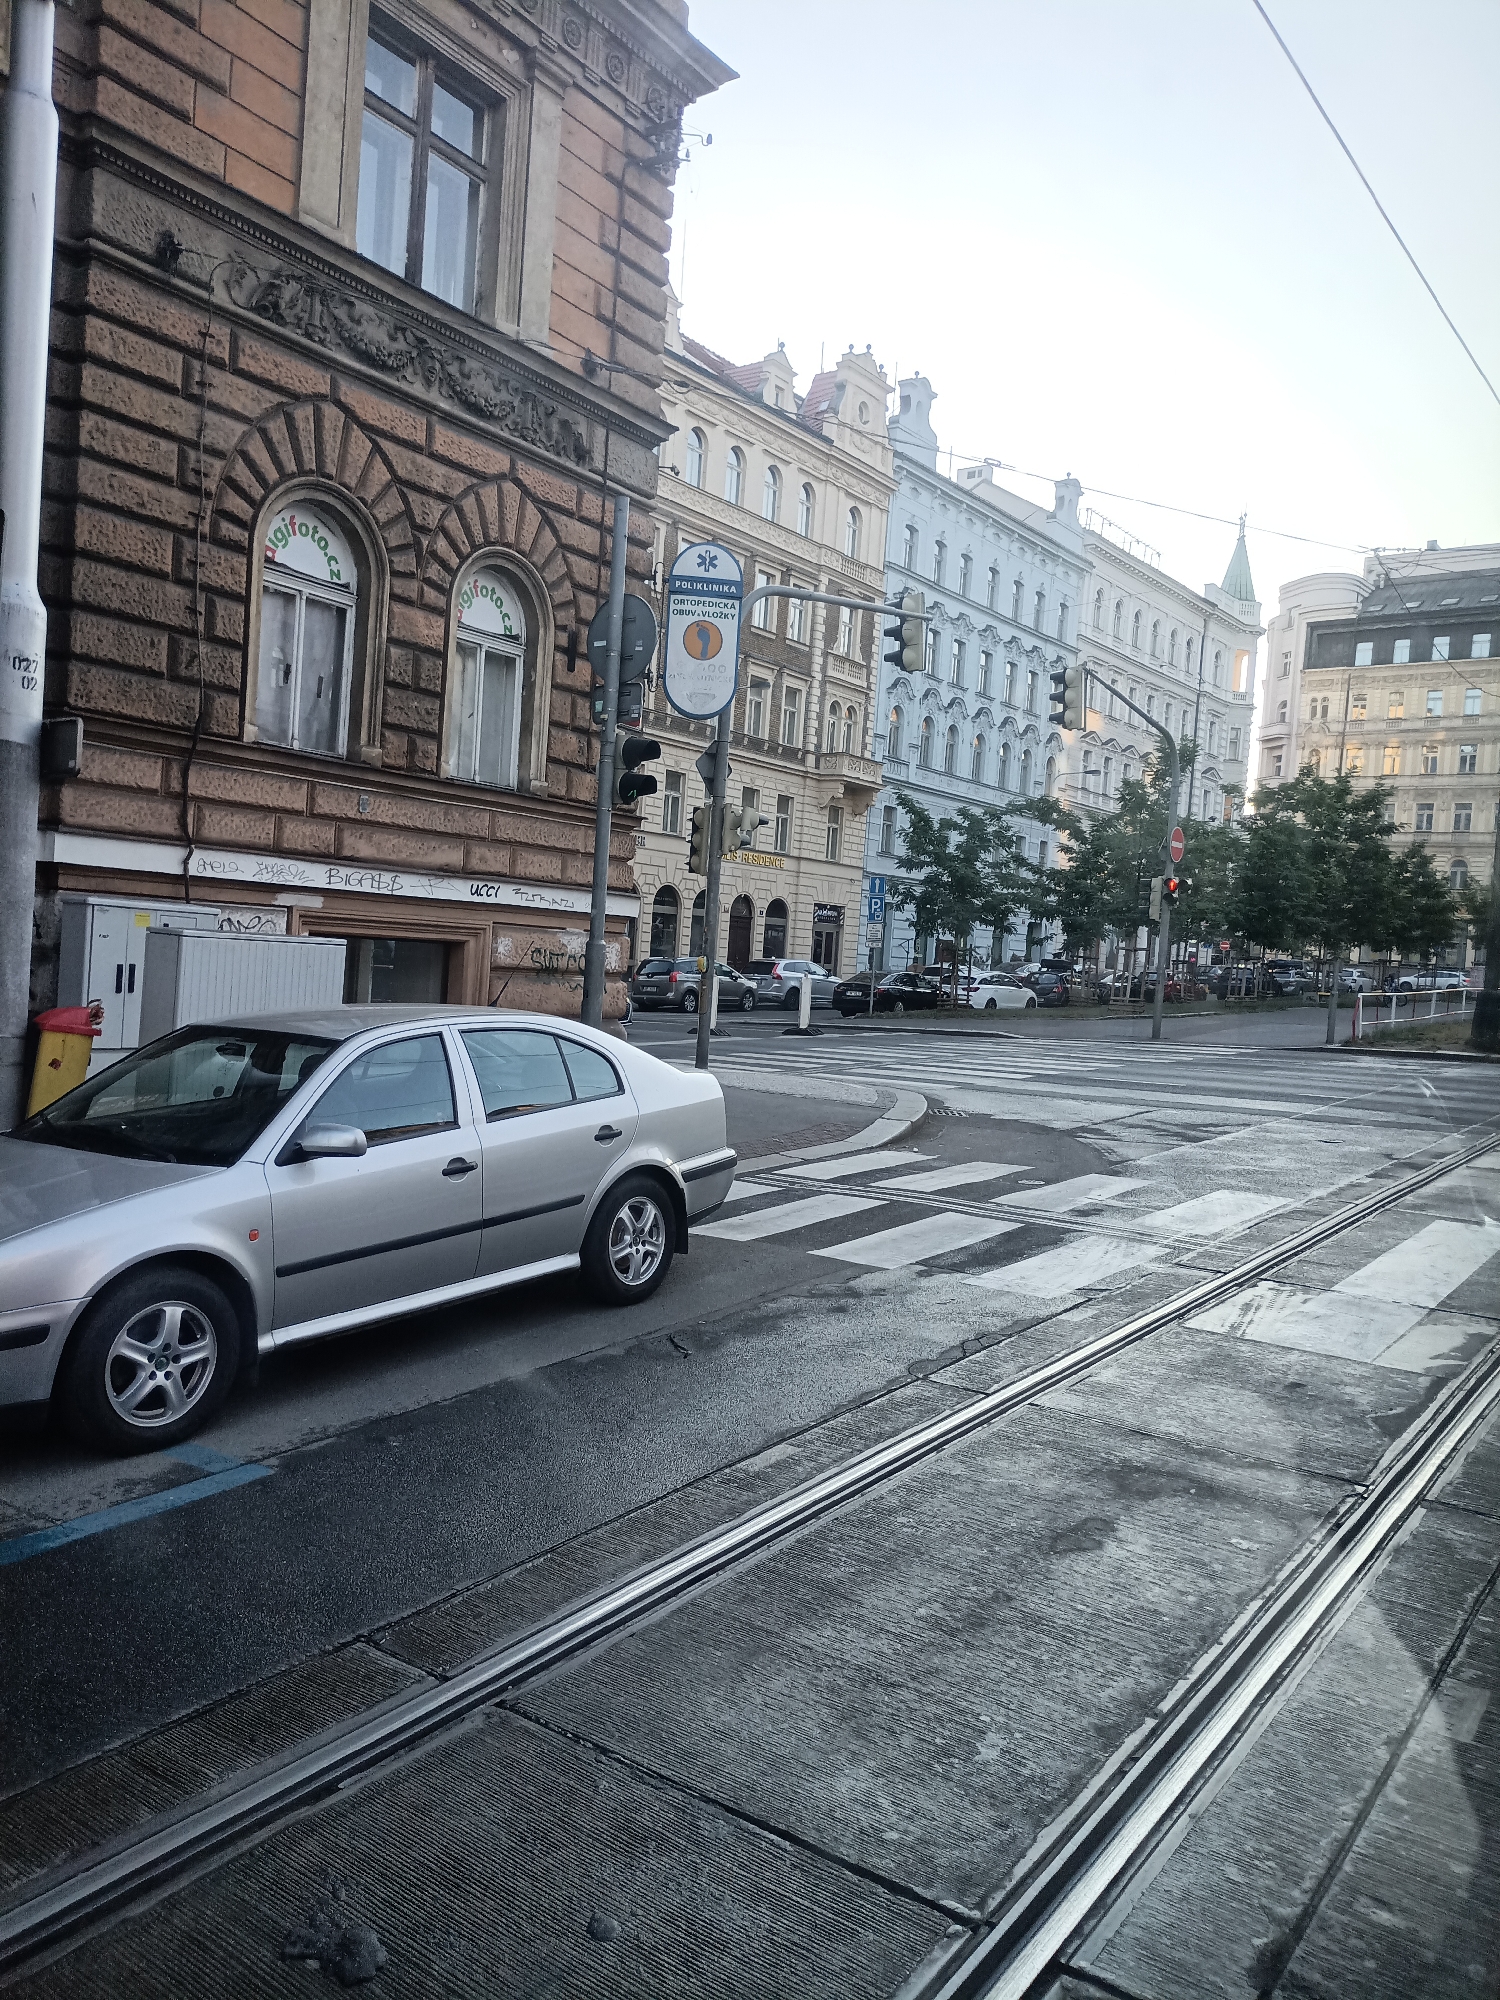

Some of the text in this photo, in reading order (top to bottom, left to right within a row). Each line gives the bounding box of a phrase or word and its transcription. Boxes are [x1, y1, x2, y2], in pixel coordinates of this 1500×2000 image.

[675, 580, 737, 593] POLIKLINIKA
[673, 598, 736, 610] ORTOPEDICKÁ
[672, 608, 697, 617] OBUV
[701, 609, 736, 620] VLOŽKY
[21, 675, 38, 691] 02
[741, 852, 786, 869] RESIDENCE
[871, 898, 880, 914] P
